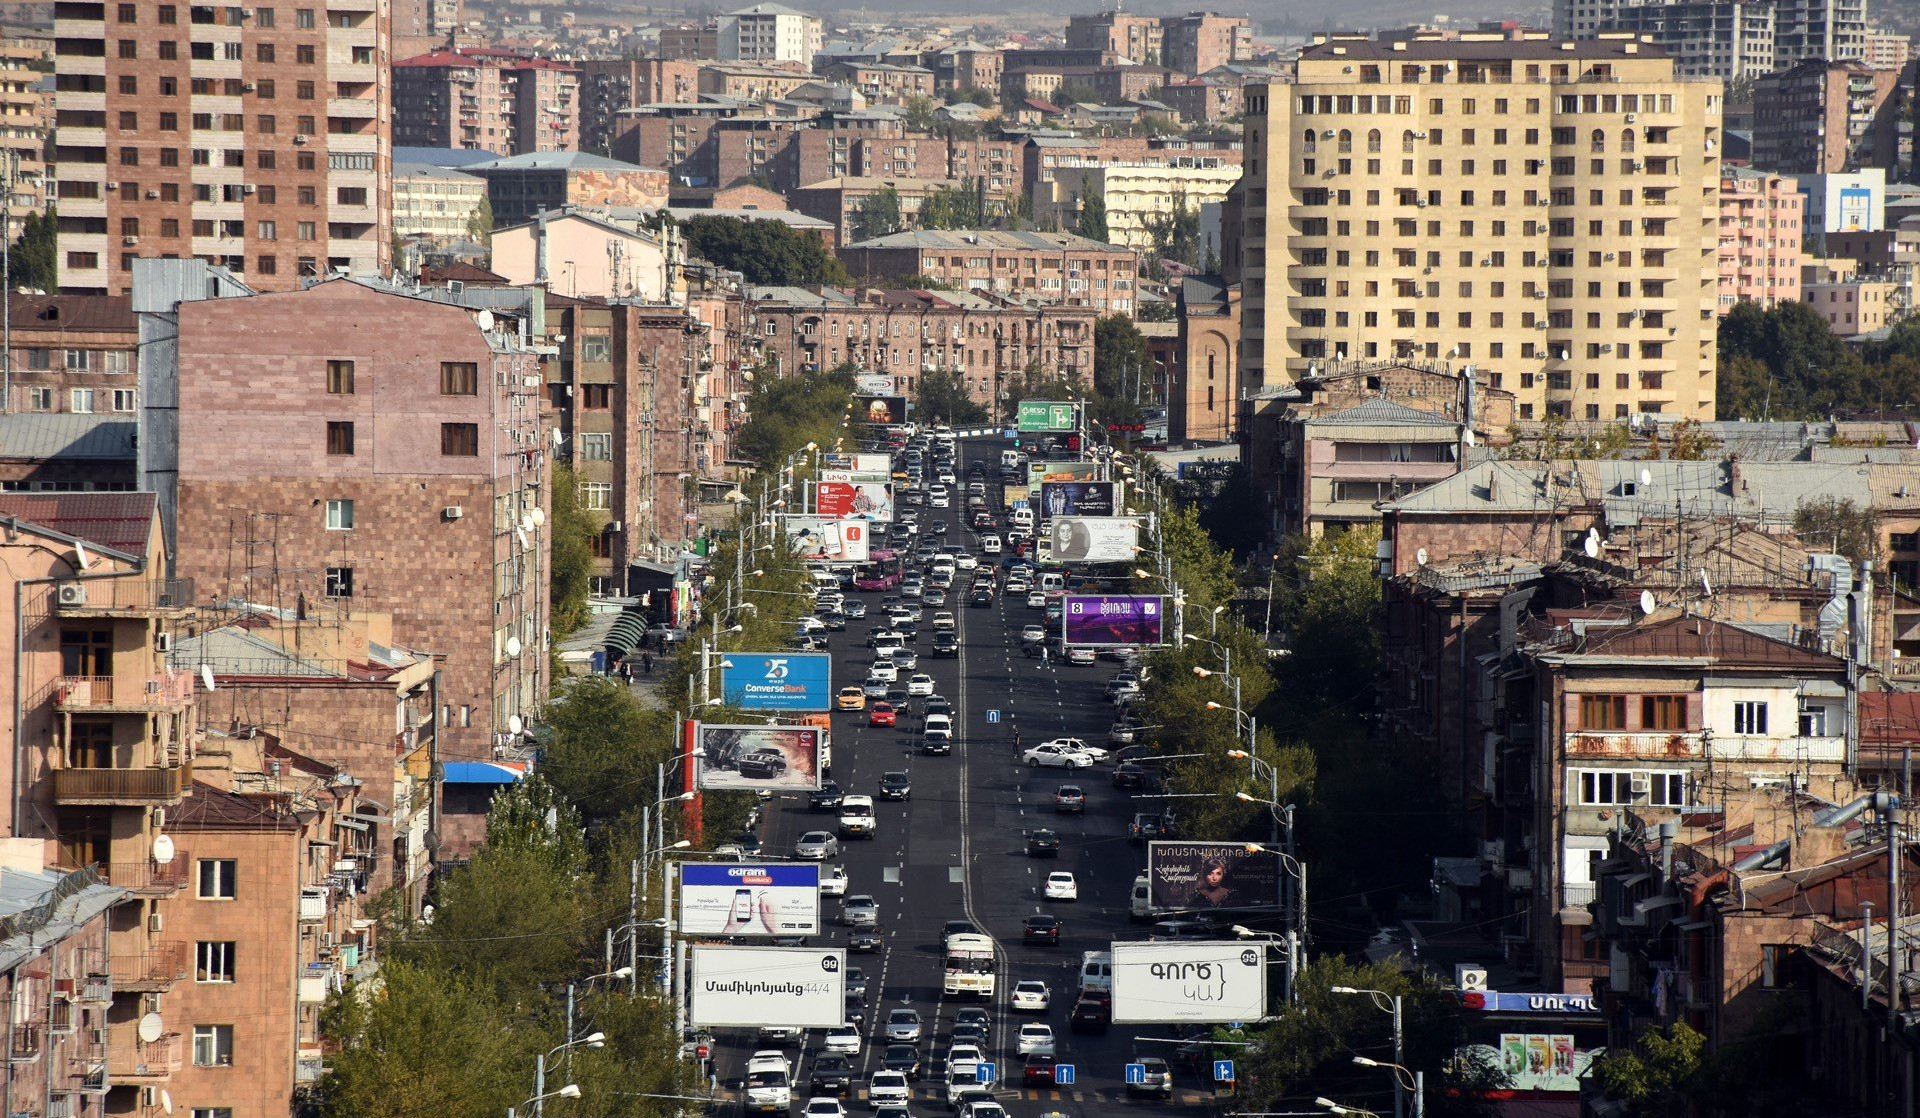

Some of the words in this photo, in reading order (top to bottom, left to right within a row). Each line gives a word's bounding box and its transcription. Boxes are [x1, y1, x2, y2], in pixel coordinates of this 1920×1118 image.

[1073, 604, 1081, 613] 8
[764, 659, 789, 678] 25
[745, 684, 806, 693] ConverseBank
[1242, 953, 1257, 963] gg
[823, 959, 837, 969] gg
[1151, 963, 1212, 980] ԳՈՐԾ
